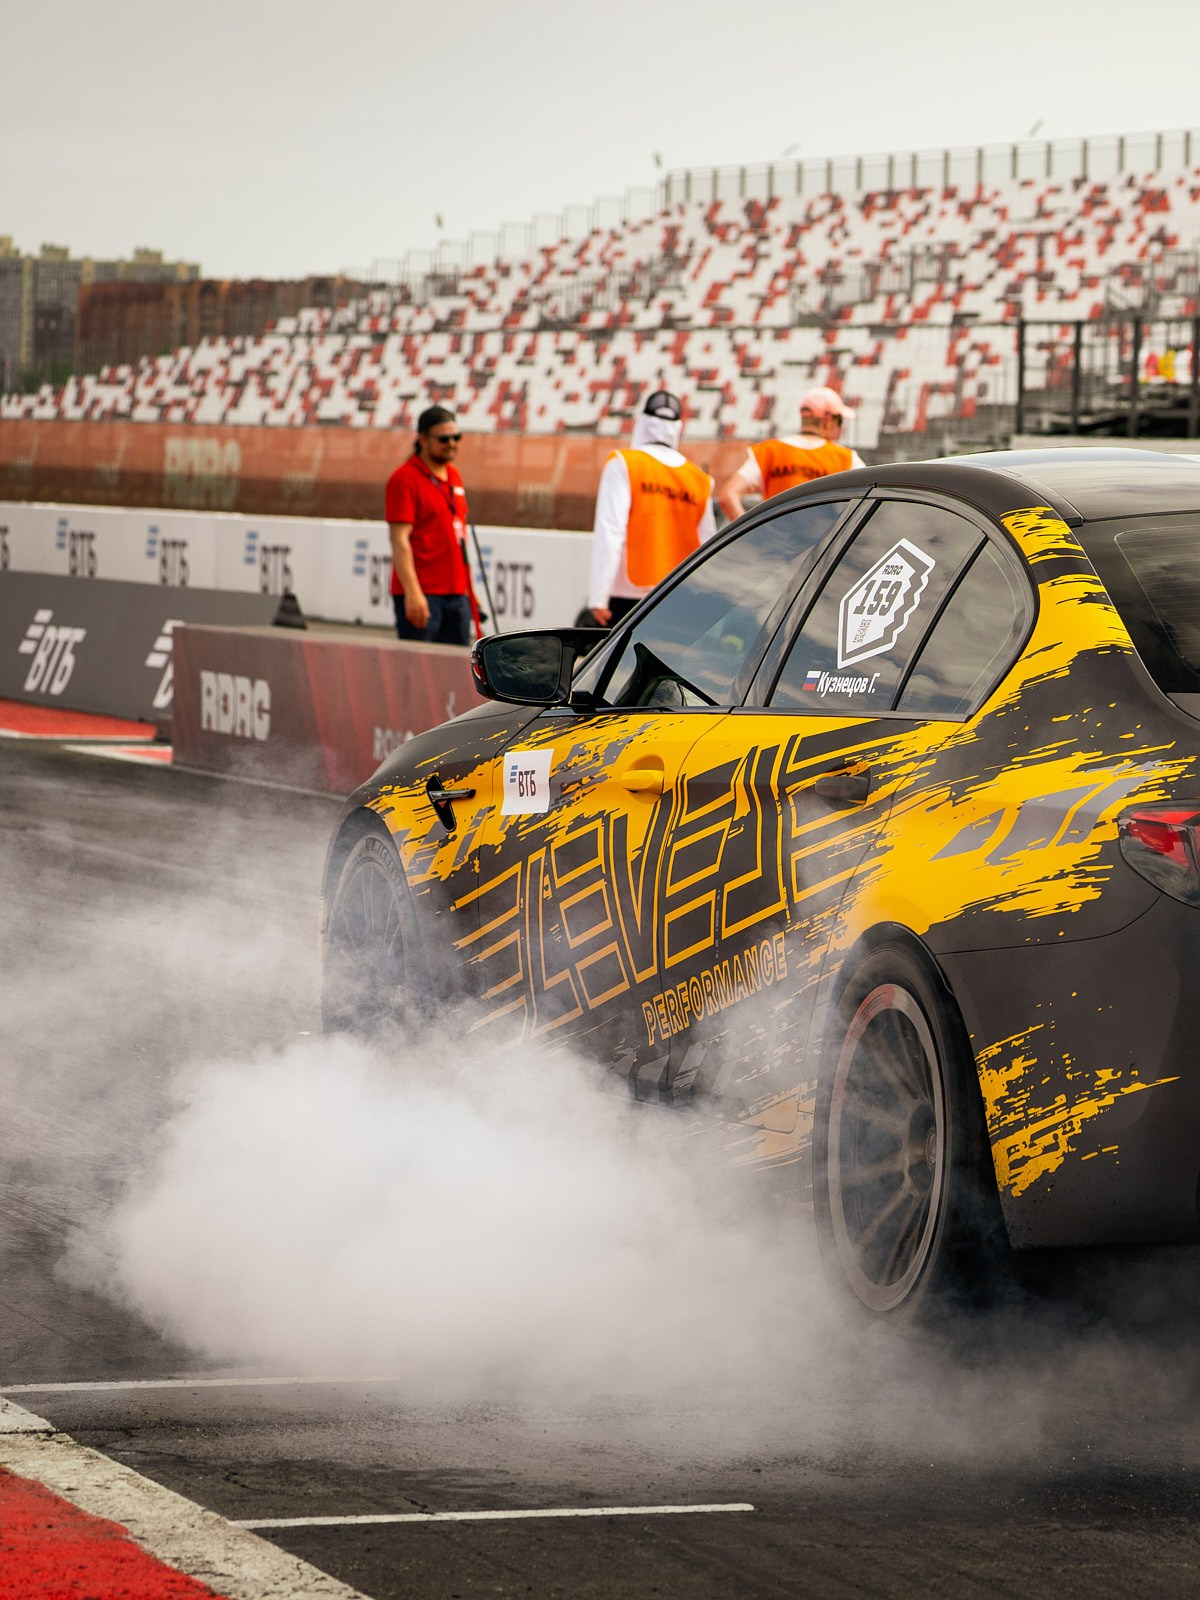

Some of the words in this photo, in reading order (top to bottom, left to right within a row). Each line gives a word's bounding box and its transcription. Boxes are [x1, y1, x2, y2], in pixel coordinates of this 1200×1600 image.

[853, 580, 902, 616] 159
[816, 671, 869, 698] Кузнецов
[867, 672, 881, 693] Г.
[201, 670, 271, 742] RDRC
[517, 770, 536, 797] ВТБ
[641, 931, 788, 1047] PERFORMANCE
